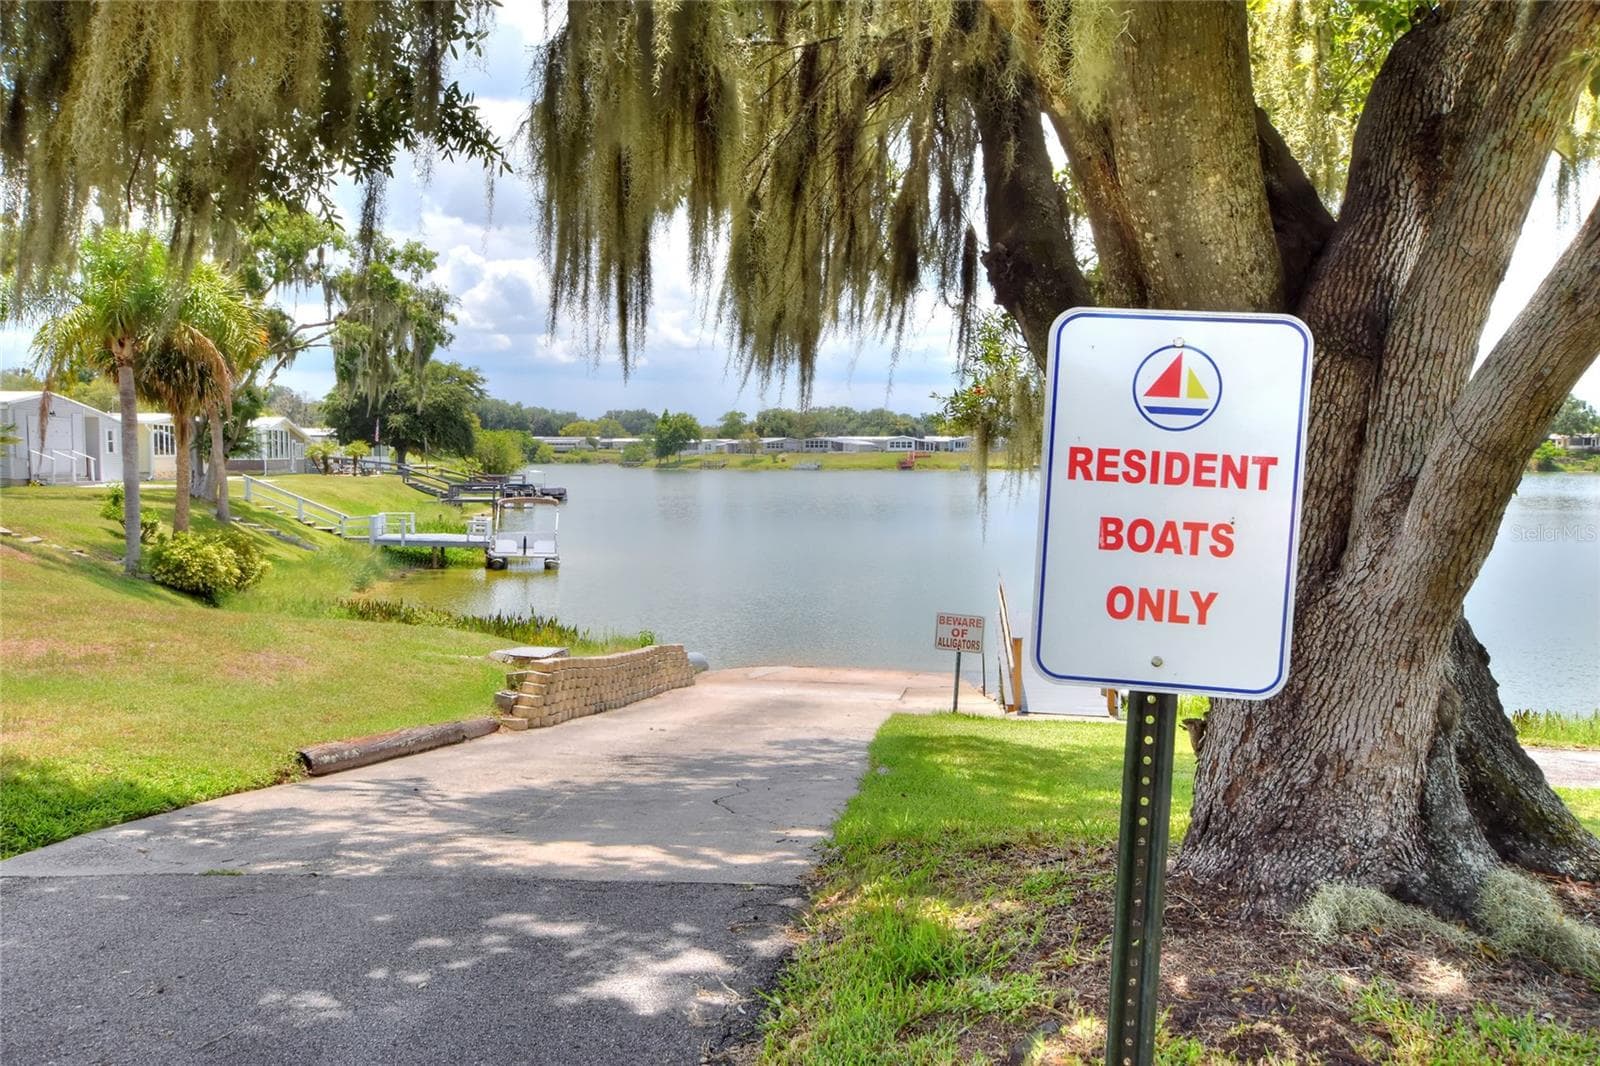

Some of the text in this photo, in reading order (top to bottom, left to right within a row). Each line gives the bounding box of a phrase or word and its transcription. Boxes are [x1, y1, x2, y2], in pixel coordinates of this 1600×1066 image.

[1067, 446, 1278, 491] RESIDENT
[1098, 516, 1235, 558] BOATS
[1106, 585, 1218, 625] ONLY
[938, 615, 983, 628] BEWARE
[951, 628, 968, 638] OF
[938, 637, 981, 650] ALLIGATORS
